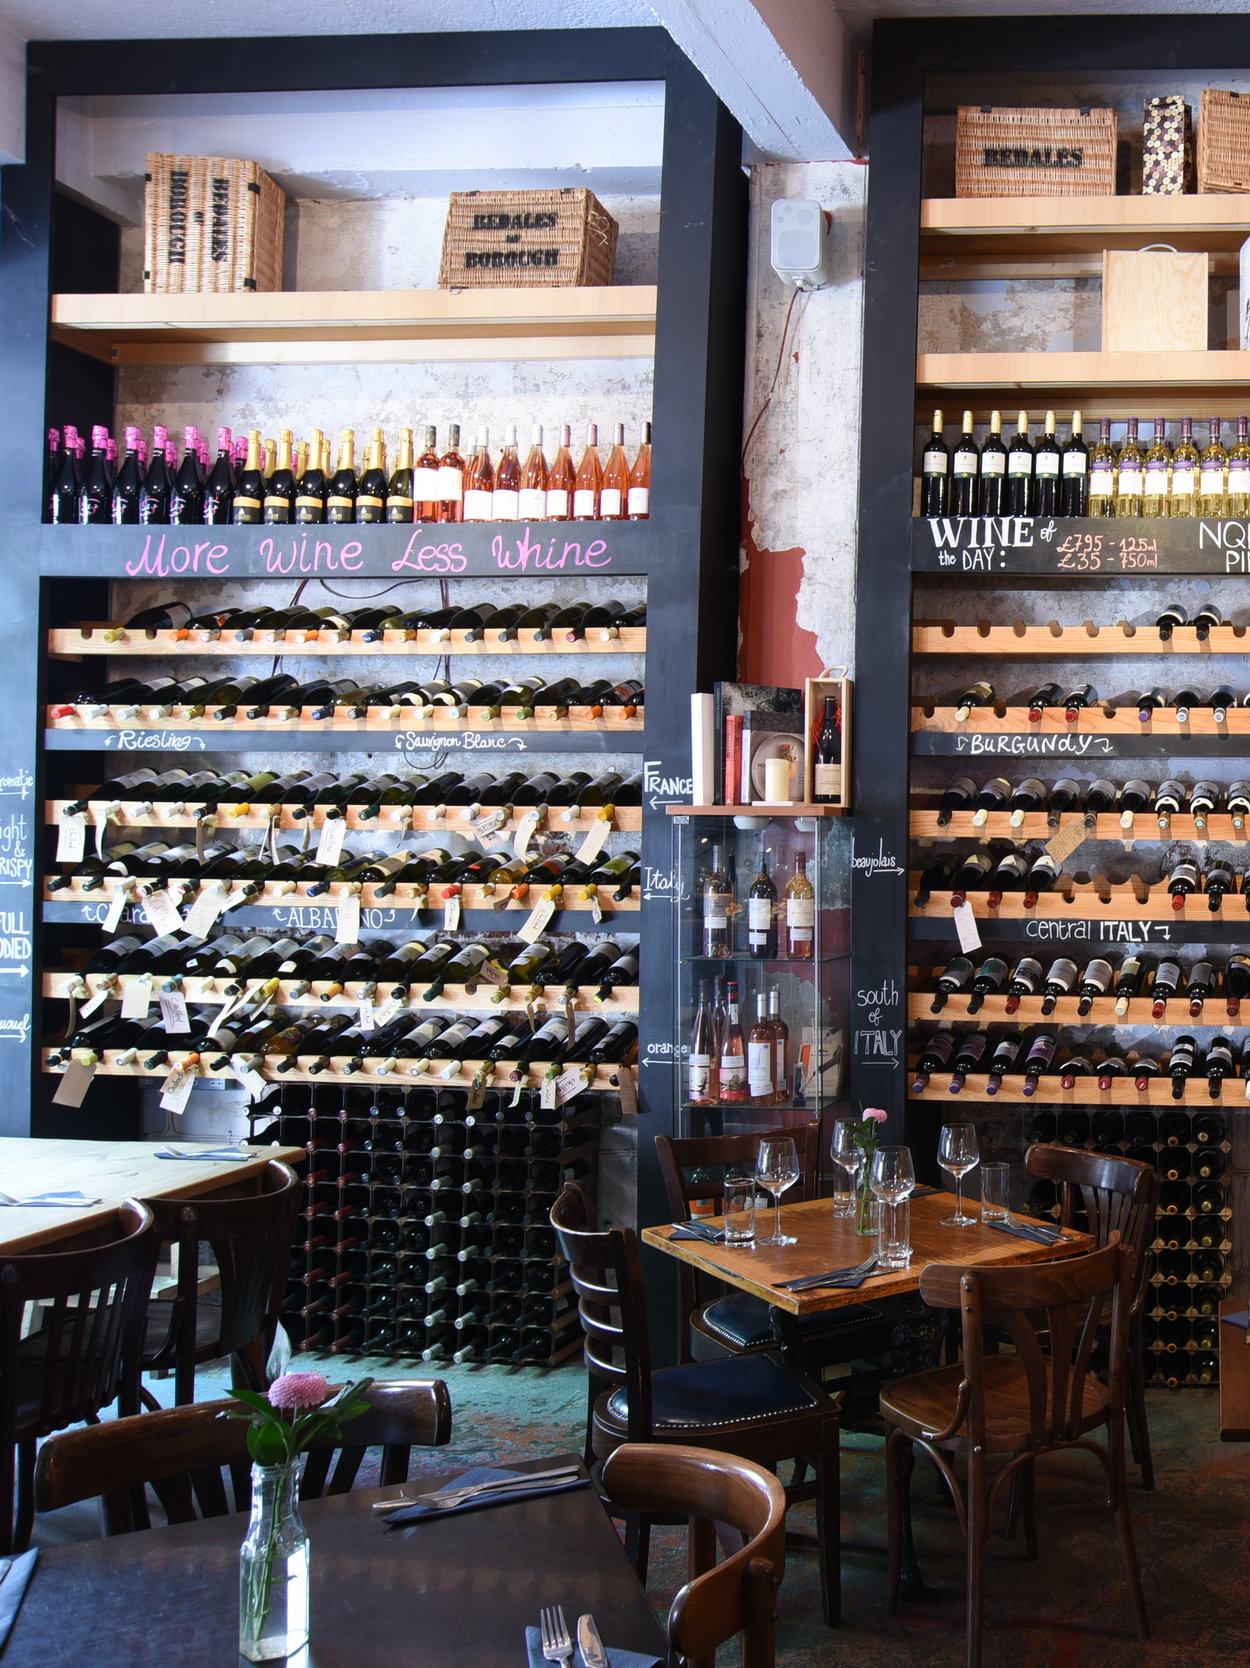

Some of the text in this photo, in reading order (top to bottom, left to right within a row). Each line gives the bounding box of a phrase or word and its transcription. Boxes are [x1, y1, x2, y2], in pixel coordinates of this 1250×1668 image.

[983, 146, 1083, 168] BEDALES
[168, 170, 188, 264] BOROUGH
[472, 212, 559, 230] BEDALES
[464, 248, 561, 269] BOROUGH
[927, 515, 1058, 549] WINE of
[126, 534, 230, 576] More
[392, 529, 468, 573] Less
[938, 550, 956, 566] the
[1056, 552, 1101, 570] £35
[1119, 552, 1158, 569] 750ml
[117, 729, 192, 752] Riesling
[405, 731, 507, 751] Sauvignon Blanc
[851, 837, 896, 877] beaujolais
[643, 866, 690, 902] Italy
[1100, 920, 1152, 942] ITALY
[857, 979, 899, 1006] south
[868, 1007, 884, 1026] of
[646, 1042, 688, 1057] orange
[853, 1029, 902, 1056] ITALY
